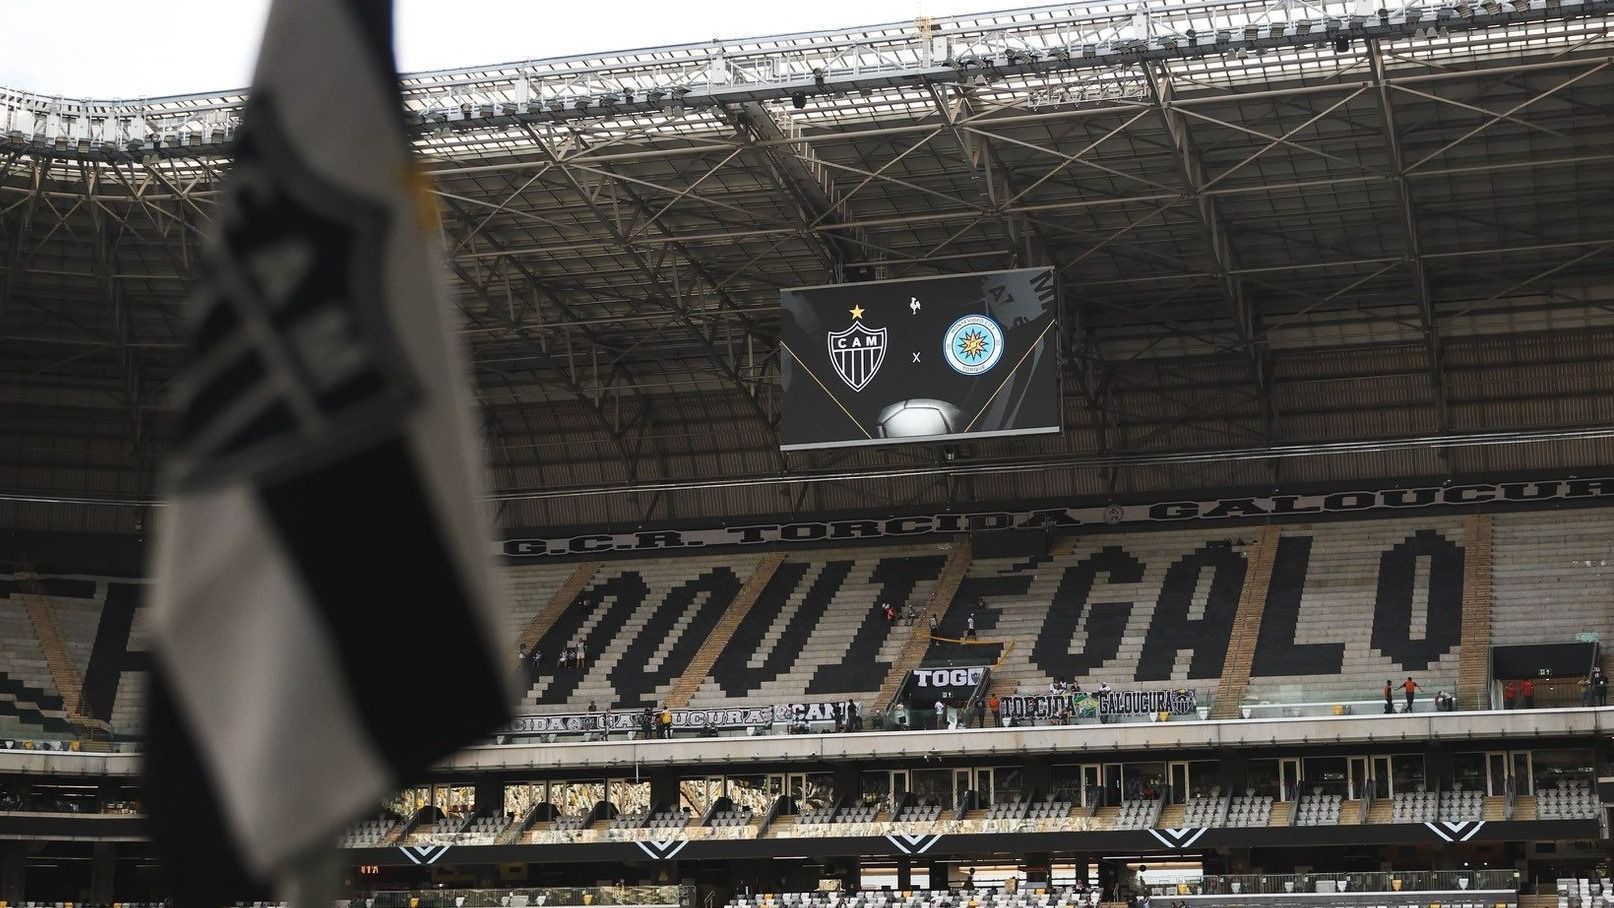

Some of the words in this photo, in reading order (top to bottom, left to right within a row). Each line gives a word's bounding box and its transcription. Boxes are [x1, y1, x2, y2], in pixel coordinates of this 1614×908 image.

[838, 336, 877, 348] CAM
[503, 530, 704, 555] G.C.R.
[727, 509, 1081, 543] TORCIDA
[1030, 529, 1466, 682] GALO
[598, 710, 763, 730] GAUCURA
